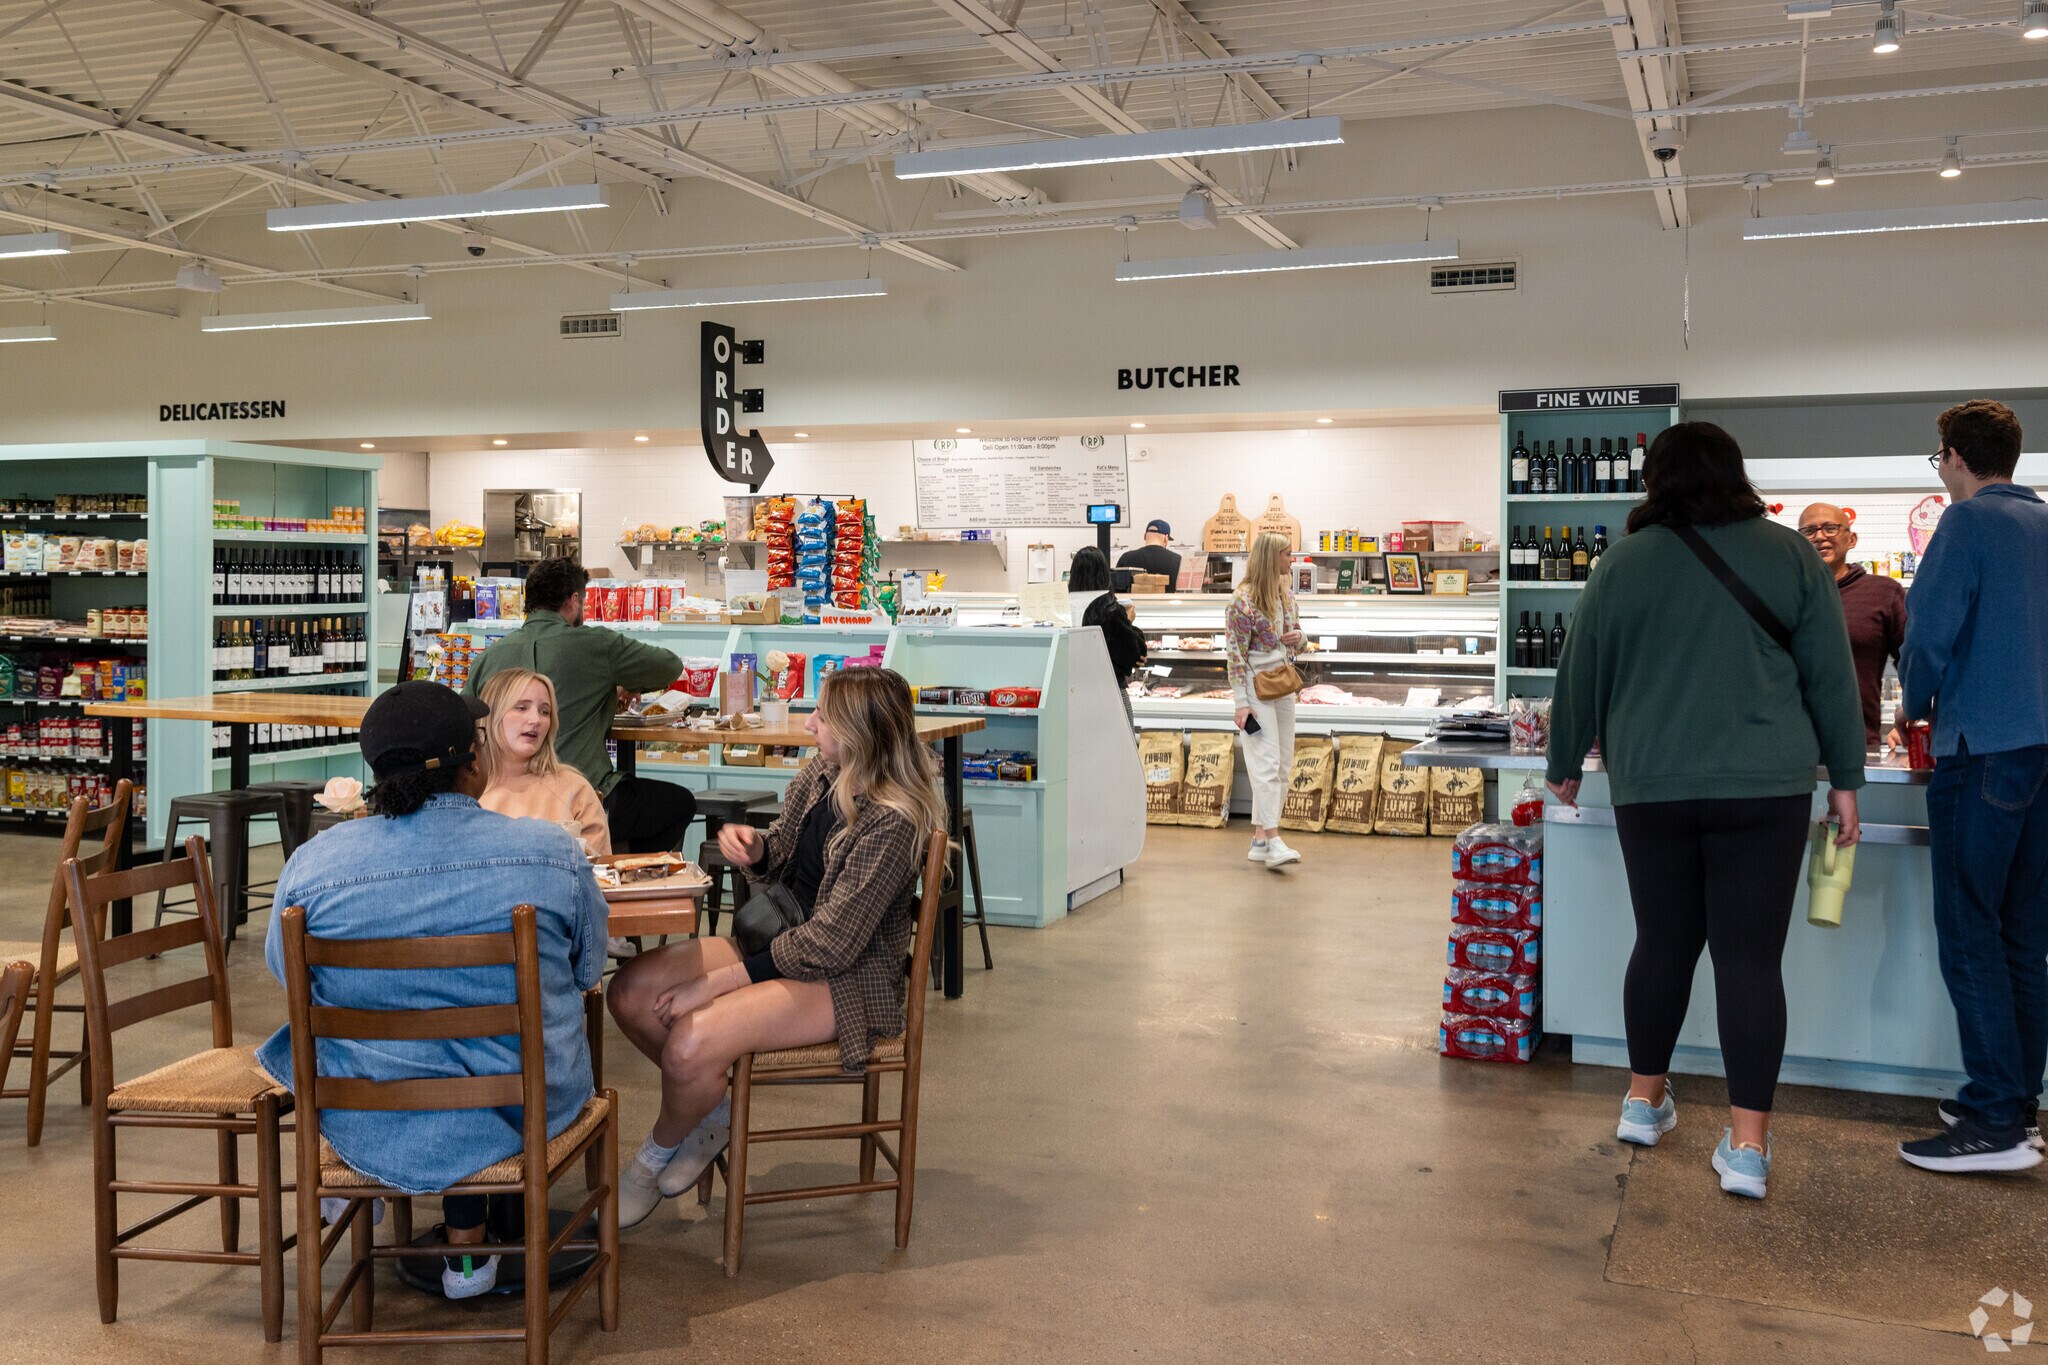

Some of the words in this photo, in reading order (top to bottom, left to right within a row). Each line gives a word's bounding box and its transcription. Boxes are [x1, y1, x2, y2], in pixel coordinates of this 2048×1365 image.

[1118, 365, 1240, 389] BUTCHER
[1536, 392, 1580, 408] FINE
[1587, 389, 1640, 407] WINE
[160, 400, 285, 422] DELICATESSEN
[715, 336, 754, 475] ORDER
[822, 616, 838, 624] HEY
[839, 616, 872, 624] CHAMP
[1144, 752, 1172, 765] COWBOY
[1342, 758, 1370, 771] COWBOY
[1146, 792, 1171, 804] UMP
[1185, 793, 1215, 806] LUMP
[1285, 797, 1313, 810] LUMP
[1184, 805, 1214, 813] CHARCOAL
[1335, 799, 1363, 812] LUMP
[1384, 800, 1417, 812] LUMP
[1440, 802, 1473, 815] LUMP
[1284, 809, 1311, 817] CHARCOAL
[1333, 811, 1361, 819] CHARCOAL
[1383, 811, 1415, 819] CHARCOAL
